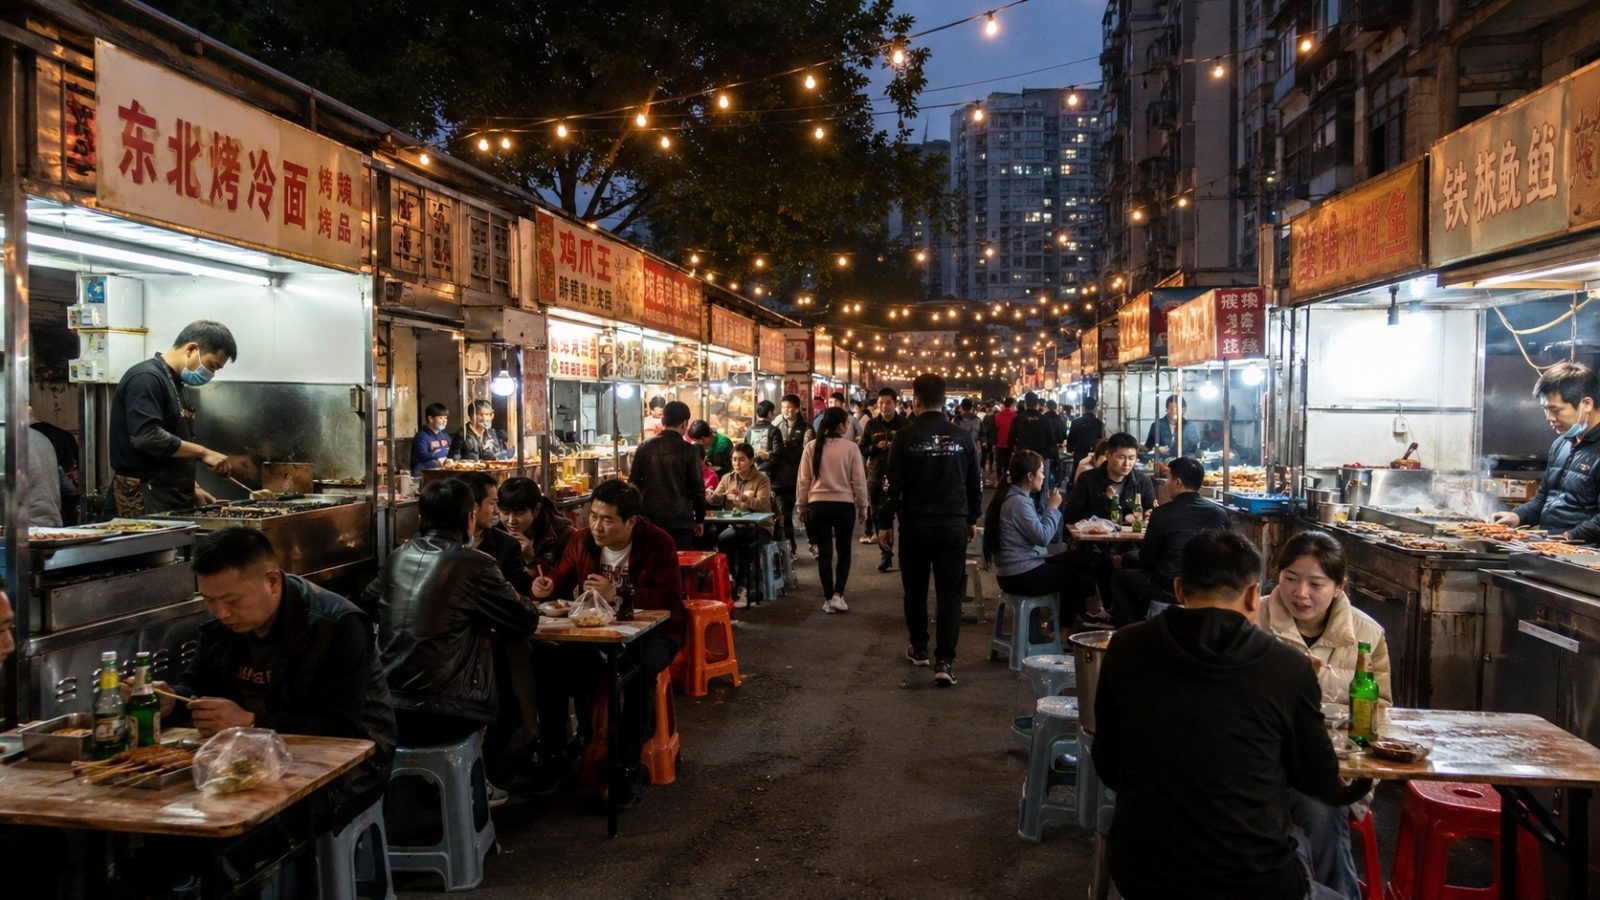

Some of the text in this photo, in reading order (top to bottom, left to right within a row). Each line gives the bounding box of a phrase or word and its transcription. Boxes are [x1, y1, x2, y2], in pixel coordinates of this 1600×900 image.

[118, 99, 309, 230] 东北烤冷面
[558, 229, 612, 283] 鸡爪王
